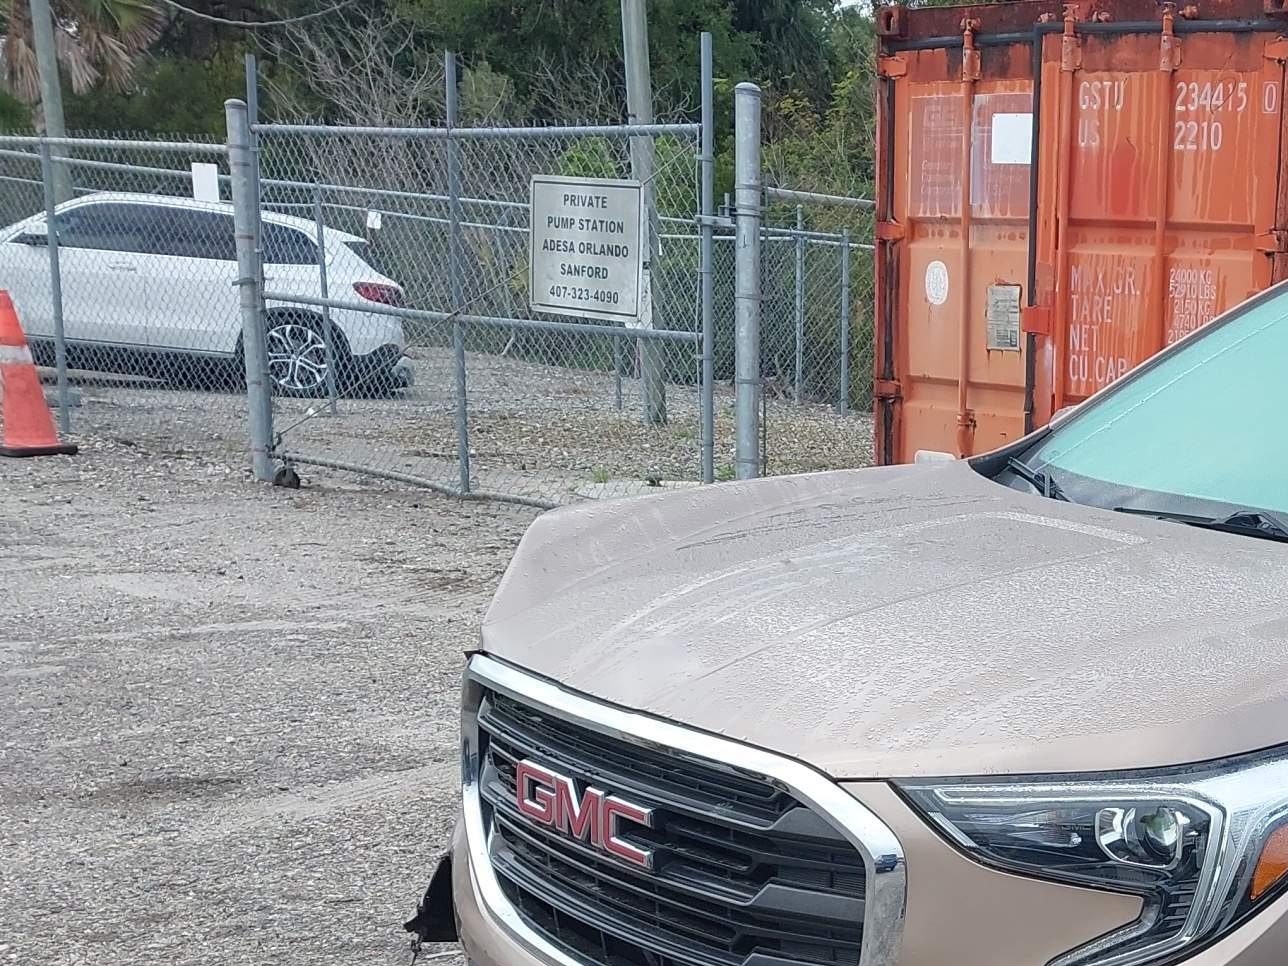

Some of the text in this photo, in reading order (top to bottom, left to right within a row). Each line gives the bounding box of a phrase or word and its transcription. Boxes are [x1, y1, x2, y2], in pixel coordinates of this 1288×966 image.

[1079, 81, 1277, 112] GSTU 234415 0
[1078, 119, 1222, 150] US 2210
[563, 194, 608, 209] PRIVATE
[547, 215, 624, 234] PUMP STATION
[542, 239, 629, 258] ADESA ORLANDO
[560, 263, 609, 279] SANFORD
[550, 285, 619, 304] 407-323-4090
[1071, 294, 1113, 323] TARE
[1069, 324, 1099, 352] NET
[517, 759, 656, 869] GMC
